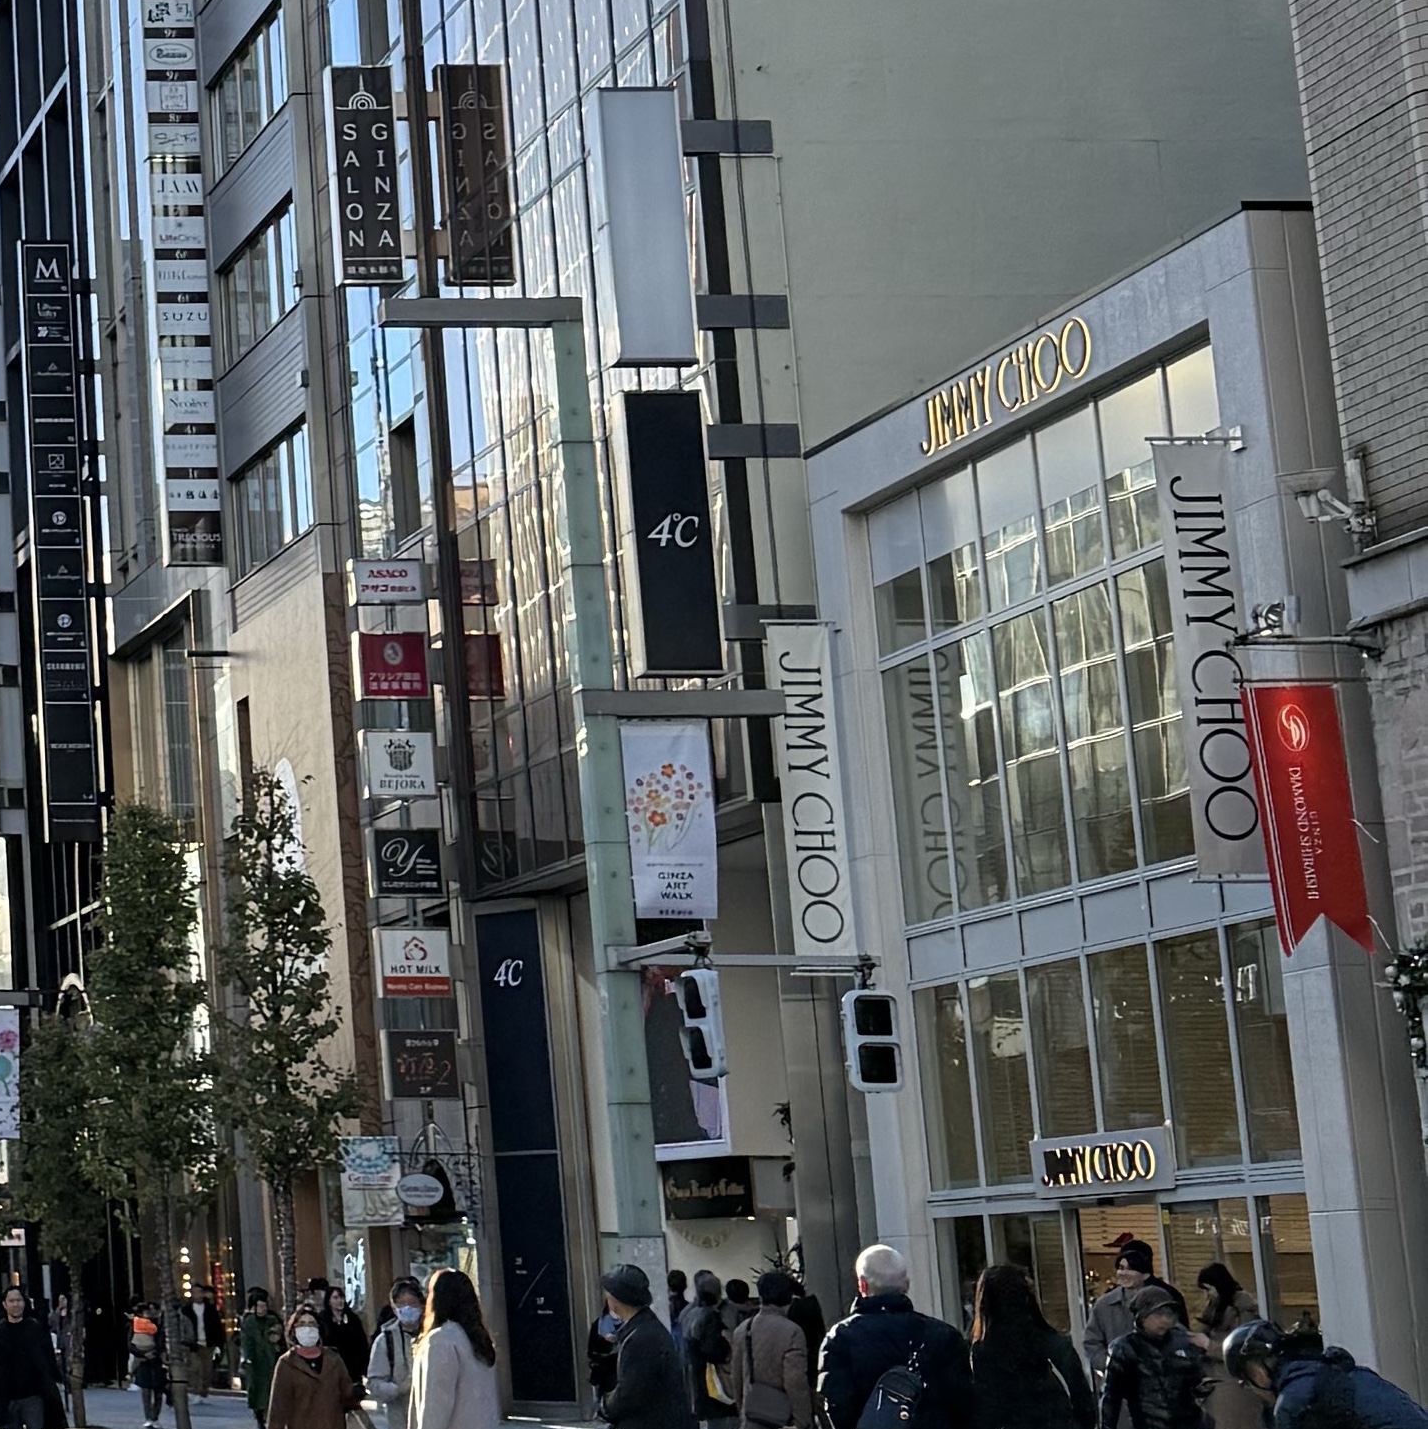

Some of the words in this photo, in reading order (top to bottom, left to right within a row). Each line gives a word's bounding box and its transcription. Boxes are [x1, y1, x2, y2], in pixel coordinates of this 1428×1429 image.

[342, 123, 365, 248] SALON
[371, 123, 395, 248] GINZA
[921, 364, 992, 457] JIMMY
[997, 316, 1091, 413] CHOO
[368, 568, 408, 579] ASACO
[1170, 475, 1239, 634] JIMMY
[778, 650, 831, 780] JIMMY
[1191, 650, 1260, 842] CHOO
[1288, 767, 1310, 832] DIAMOND
[658, 872, 694, 880] GINZA
[660, 892, 693, 900] WALK
[665, 882, 688, 890] ART
[792, 792, 845, 944] CHOO
[390, 965, 413, 974] HOT
[416, 965, 442, 974] MILK
